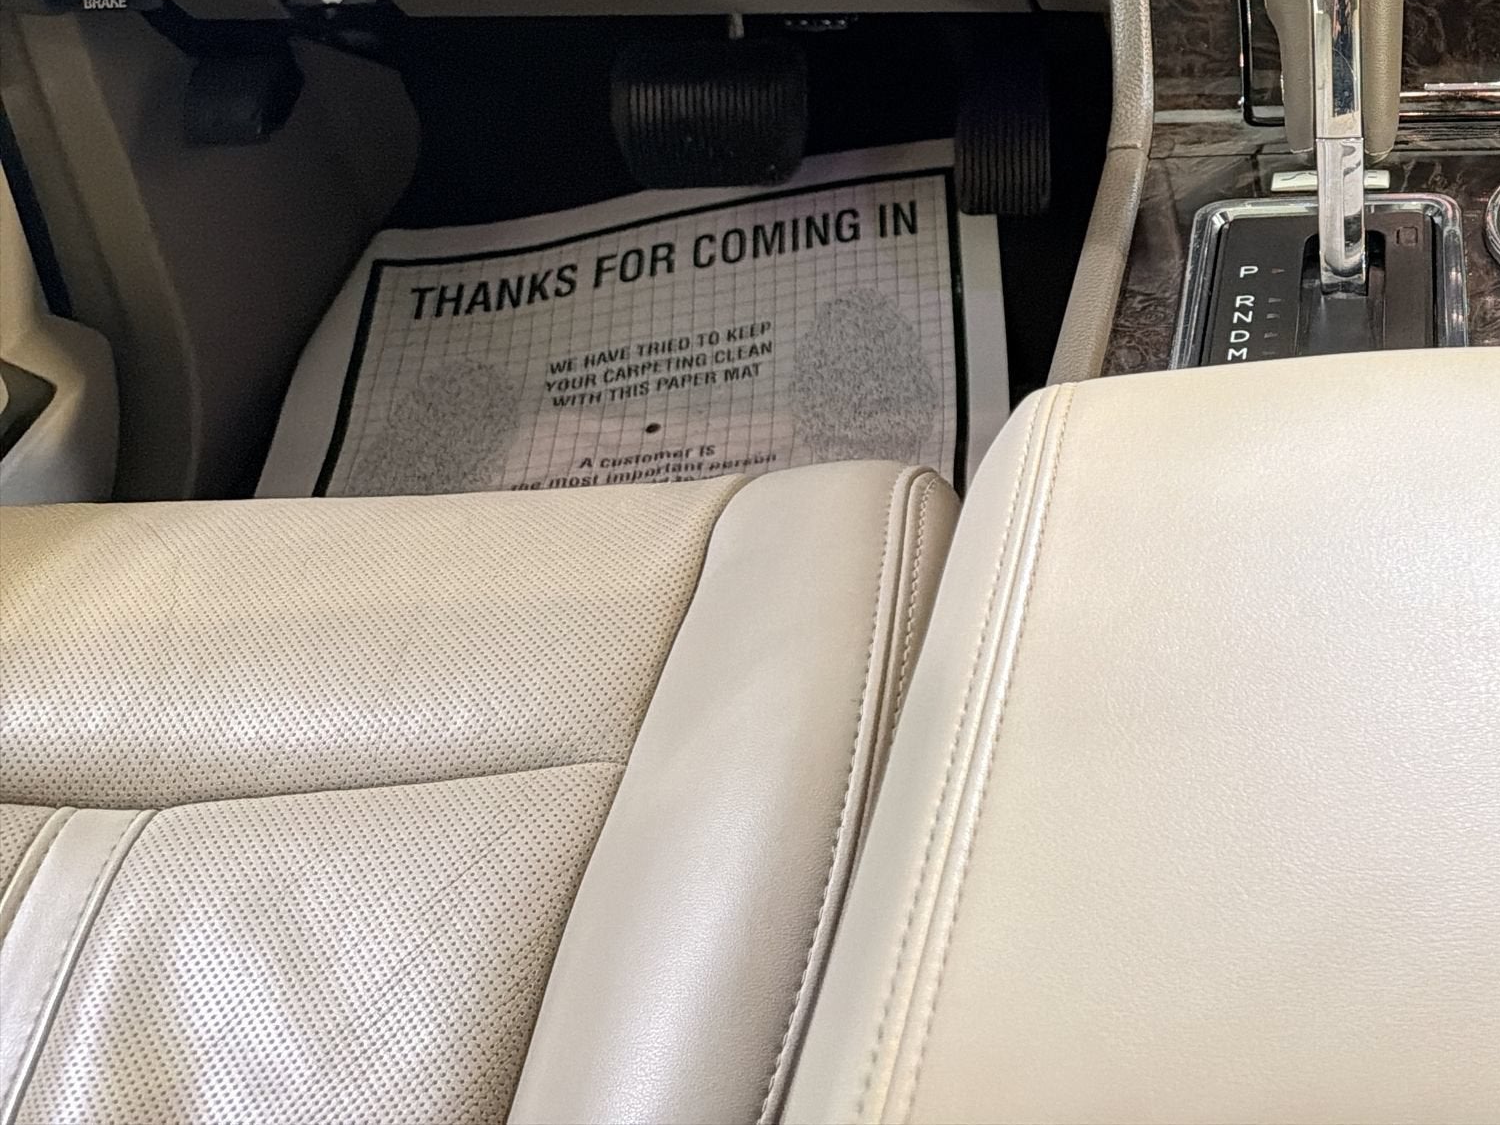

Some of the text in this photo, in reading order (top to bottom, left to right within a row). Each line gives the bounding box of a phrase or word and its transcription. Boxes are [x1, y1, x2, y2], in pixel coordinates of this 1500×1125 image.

[411, 200, 918, 320] THANKS FOR COMING IN
[1239, 265, 1259, 279] P
[1235, 294, 1255, 308] R
[1232, 310, 1253, 324] N
[1230, 330, 1250, 343] D
[550, 321, 772, 375] WE HAVE TRIED TO KEEP
[1227, 347, 1248, 361] M
[545, 340, 773, 393] YOUR CARPETING CLEAN
[552, 362, 762, 408] WITH THIS PAPER MAT
[579, 457, 593, 469] A
[549, 473, 599, 489] most
[605, 460, 703, 485] important
